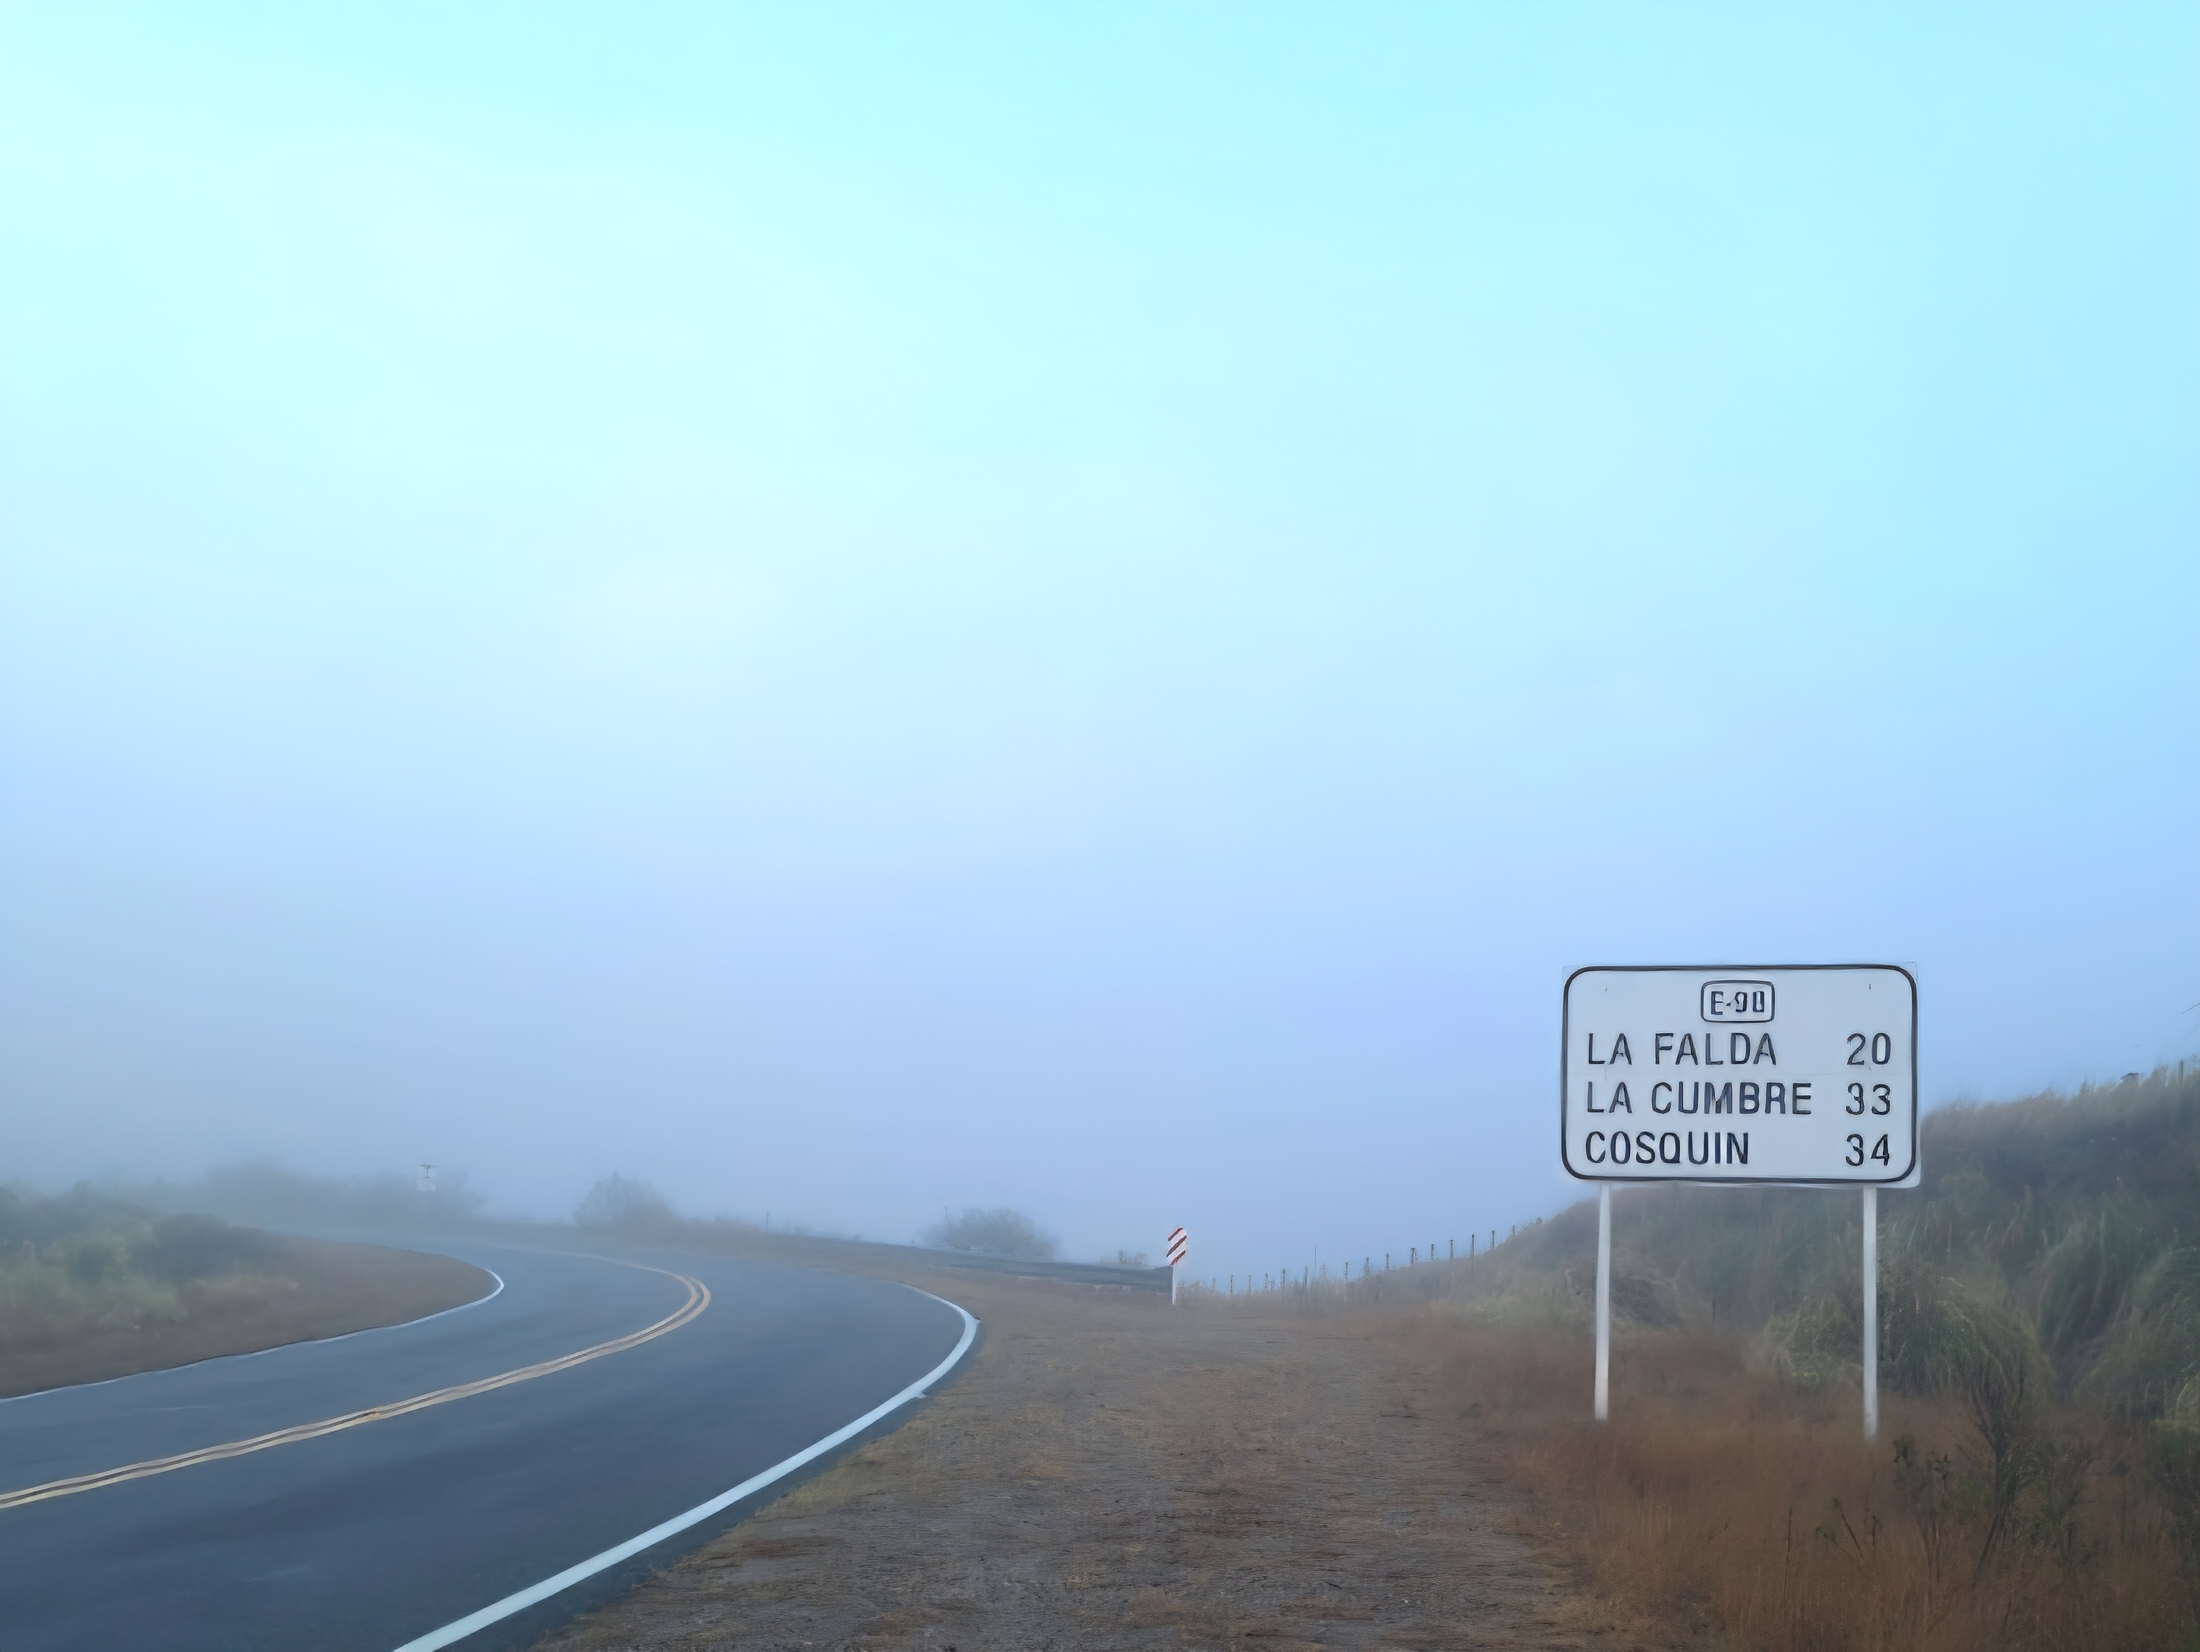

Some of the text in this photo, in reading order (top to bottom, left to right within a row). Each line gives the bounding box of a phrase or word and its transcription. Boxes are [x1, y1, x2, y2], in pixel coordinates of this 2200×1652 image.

[1587, 1032, 1892, 1066] LA FALDA 20
[1586, 1081, 1891, 1116] LA CUMBRE 33
[1585, 1130, 1891, 1167] COSQUIN 34
